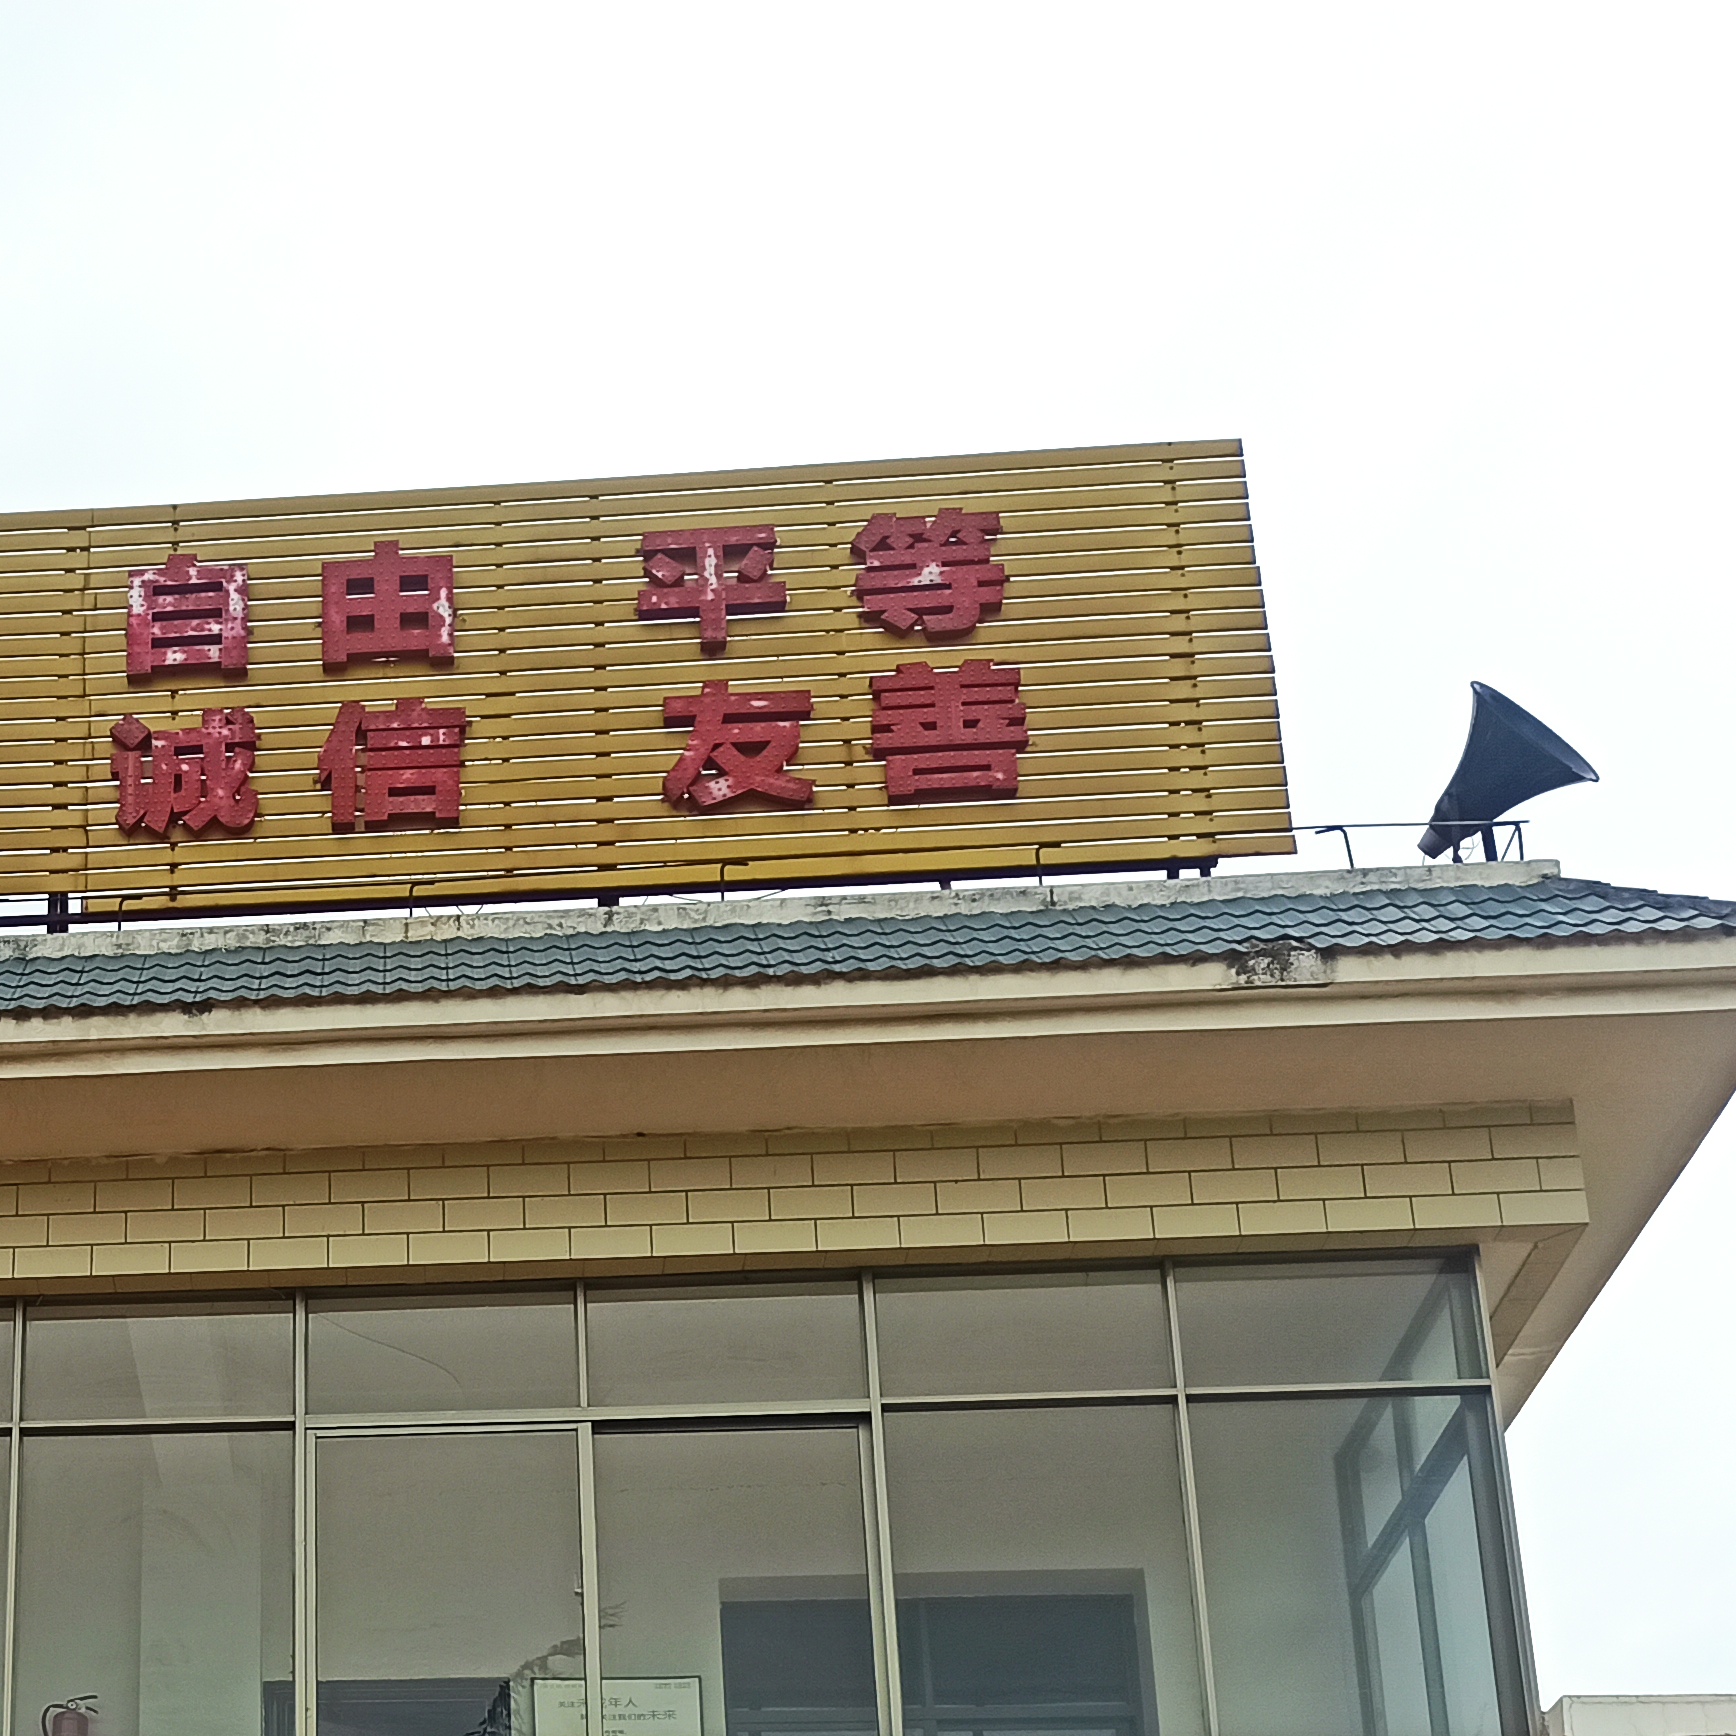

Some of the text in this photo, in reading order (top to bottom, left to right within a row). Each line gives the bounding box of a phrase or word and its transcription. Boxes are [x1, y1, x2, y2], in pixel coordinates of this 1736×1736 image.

[126, 540, 456, 686] 自由
[636, 509, 1005, 655] 平等
[110, 698, 466, 837] 诚信
[663, 660, 1028, 814] 友善
